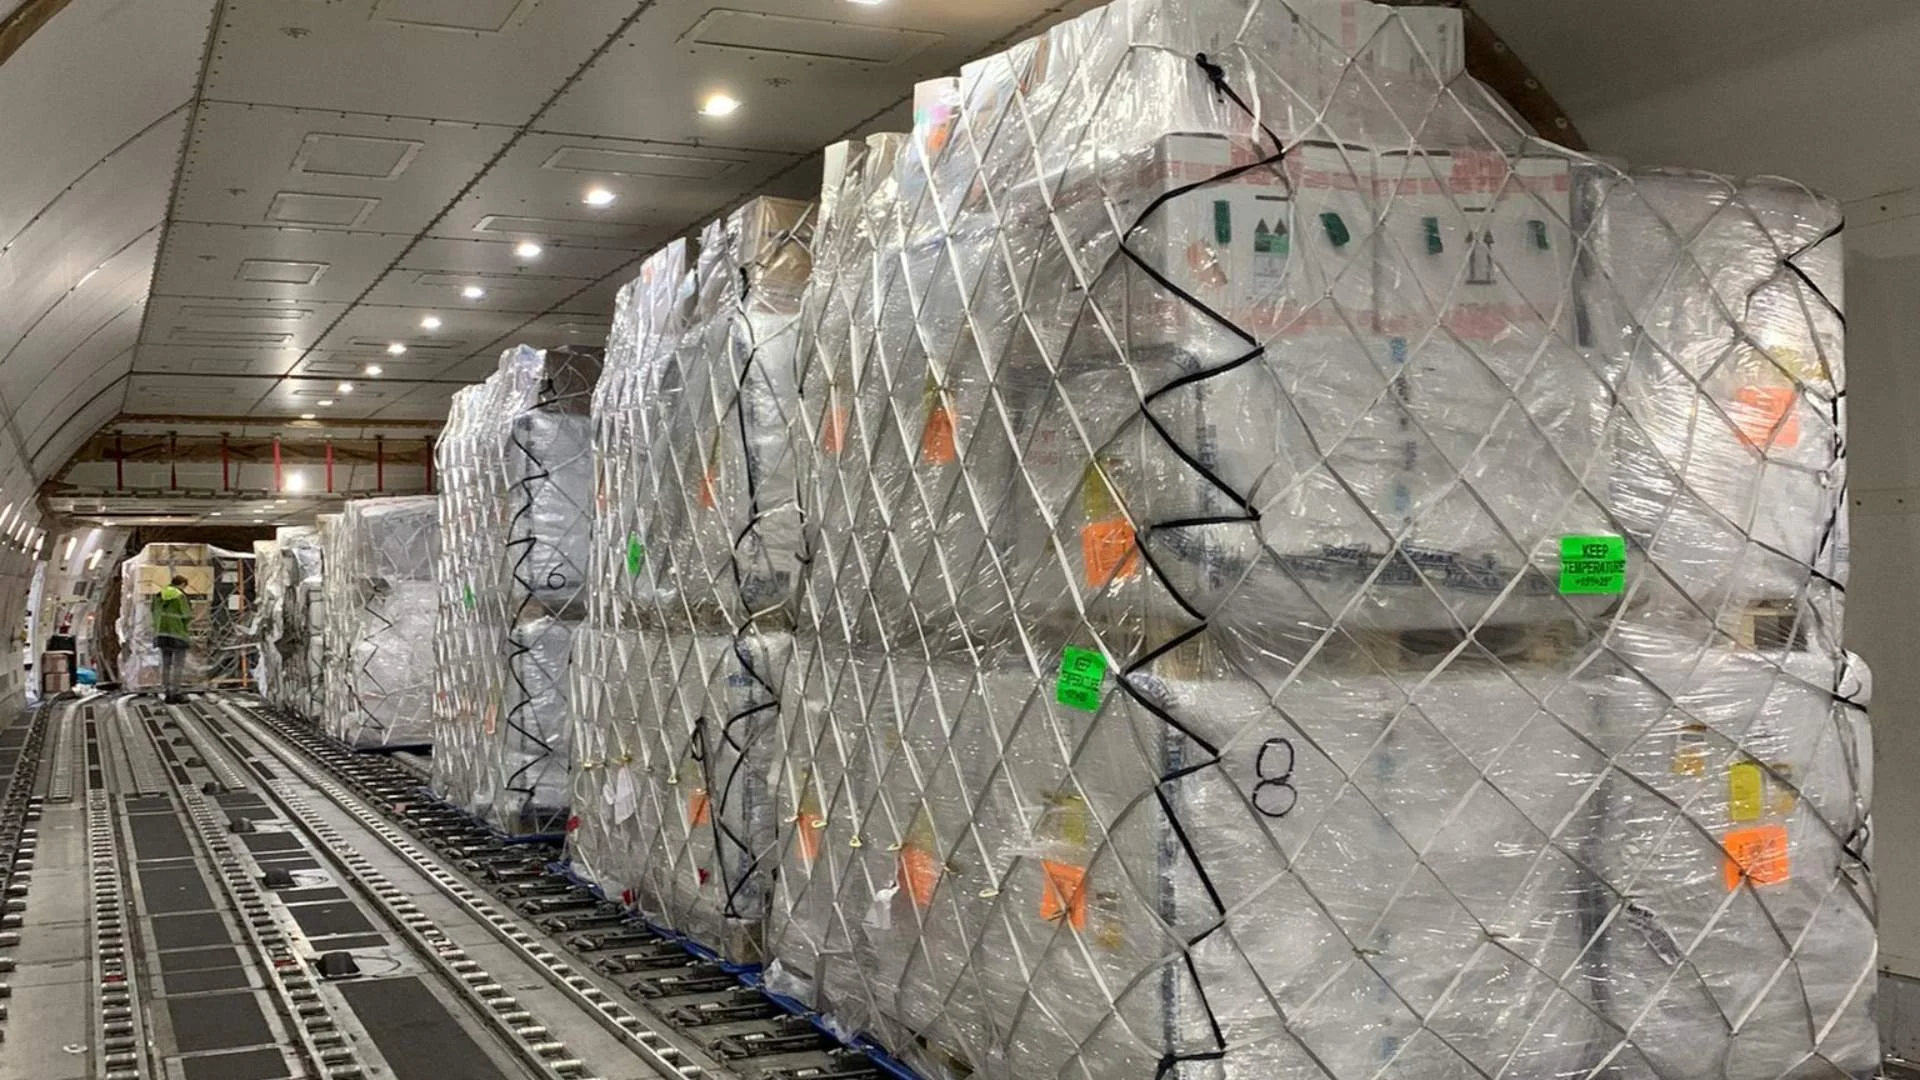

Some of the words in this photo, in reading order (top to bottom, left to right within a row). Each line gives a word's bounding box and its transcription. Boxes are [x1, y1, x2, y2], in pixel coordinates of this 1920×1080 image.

[1582, 543, 1609, 558] KEEP
[547, 562, 566, 590] 6
[1562, 559, 1625, 574] TEMPERATURE
[1252, 737, 1298, 818] 8
